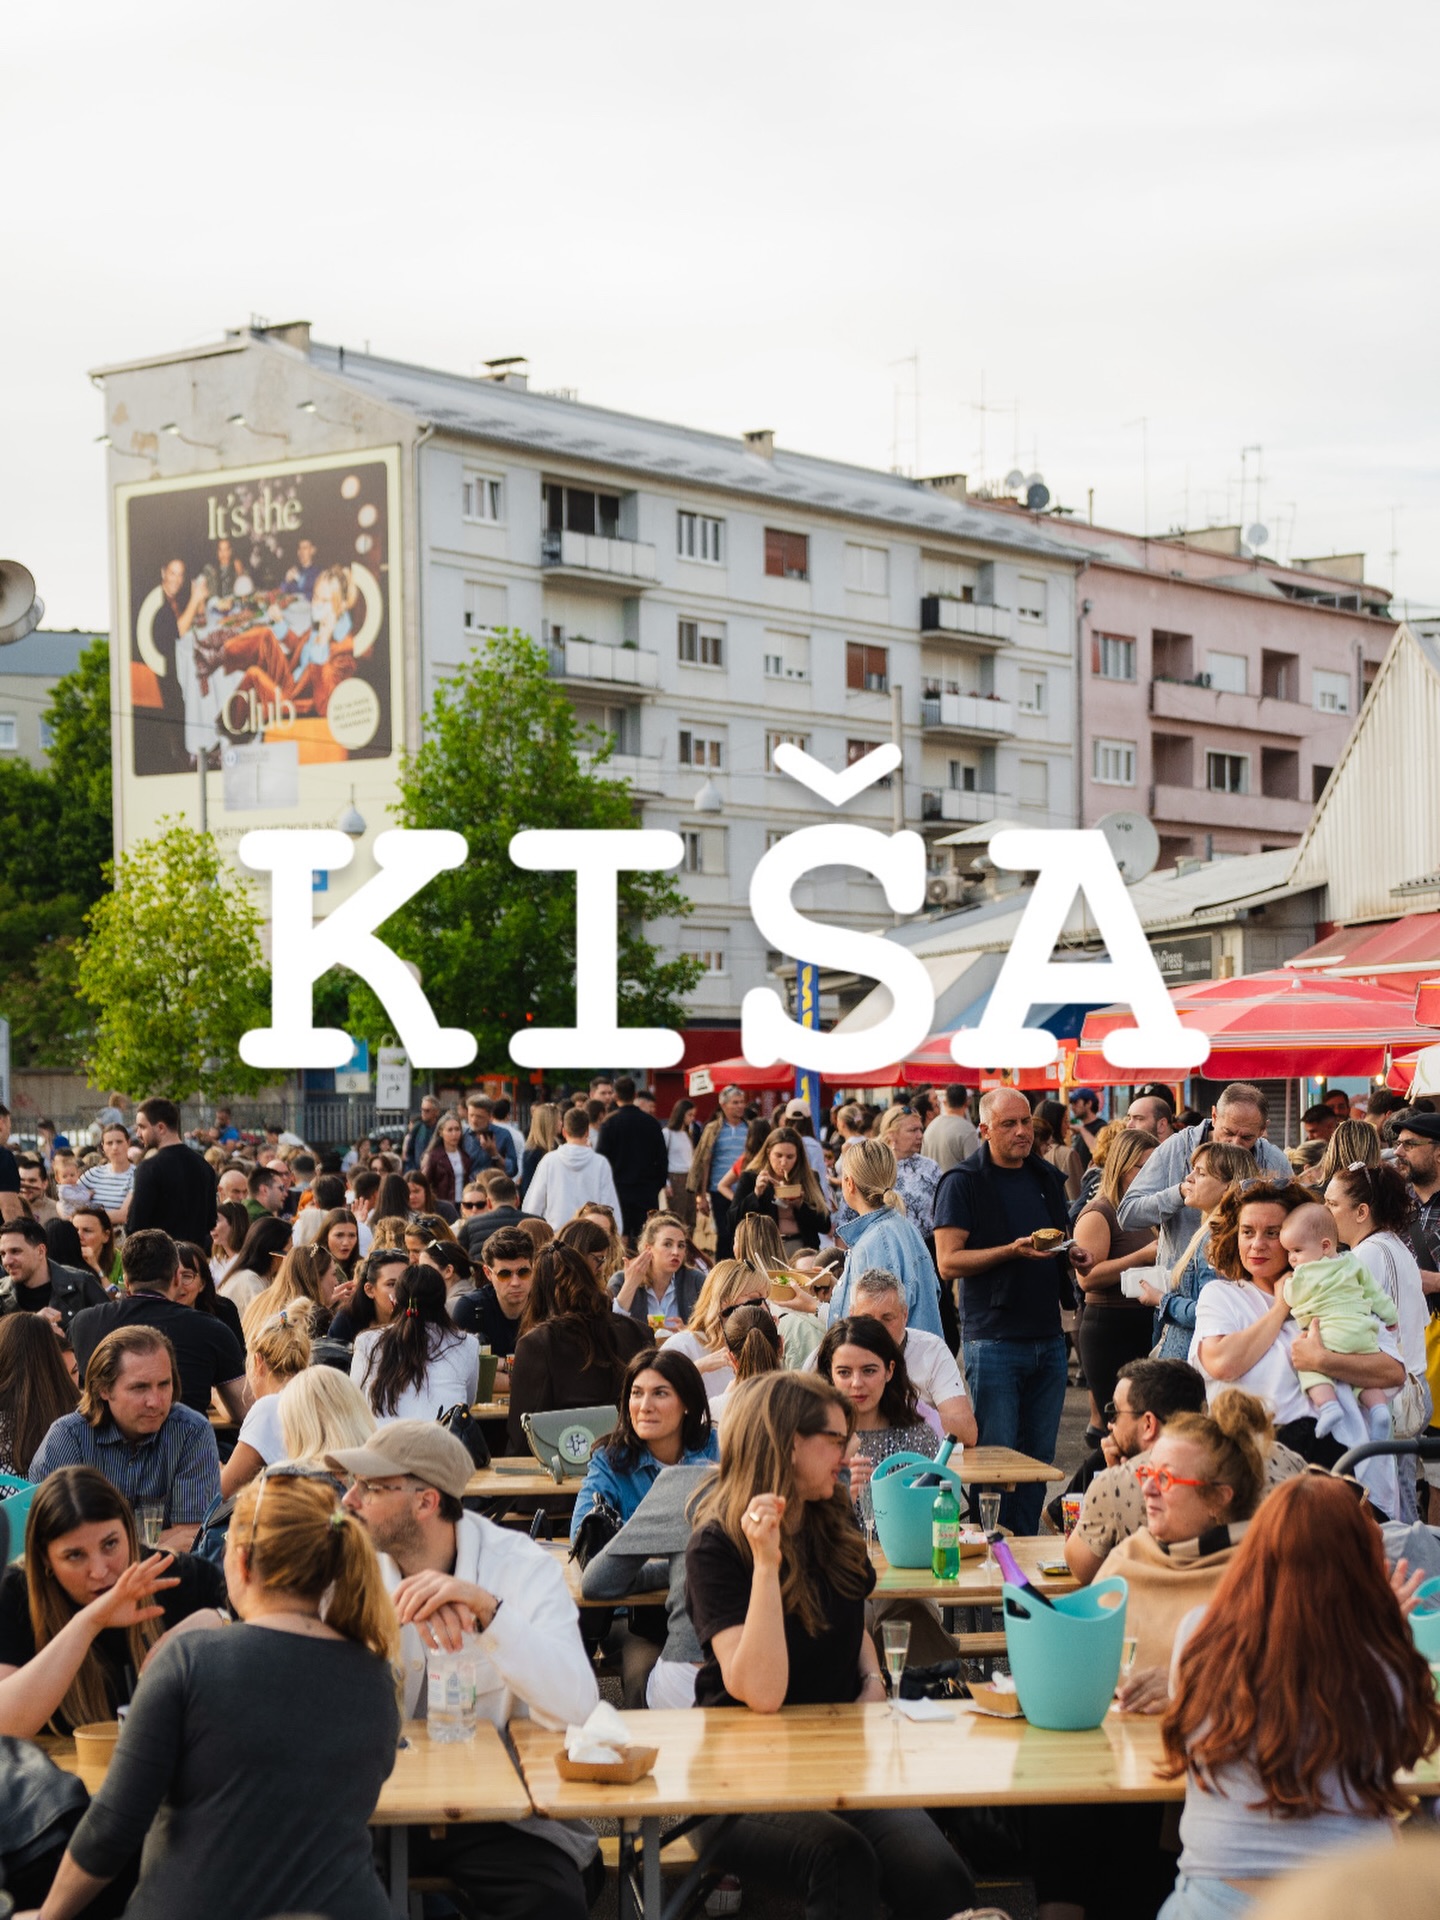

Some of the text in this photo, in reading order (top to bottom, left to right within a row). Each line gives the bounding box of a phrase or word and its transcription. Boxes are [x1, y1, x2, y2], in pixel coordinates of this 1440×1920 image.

[208, 485, 303, 541] It's the
[221, 686, 297, 736] Club
[1116, 821, 1133, 832] vip
